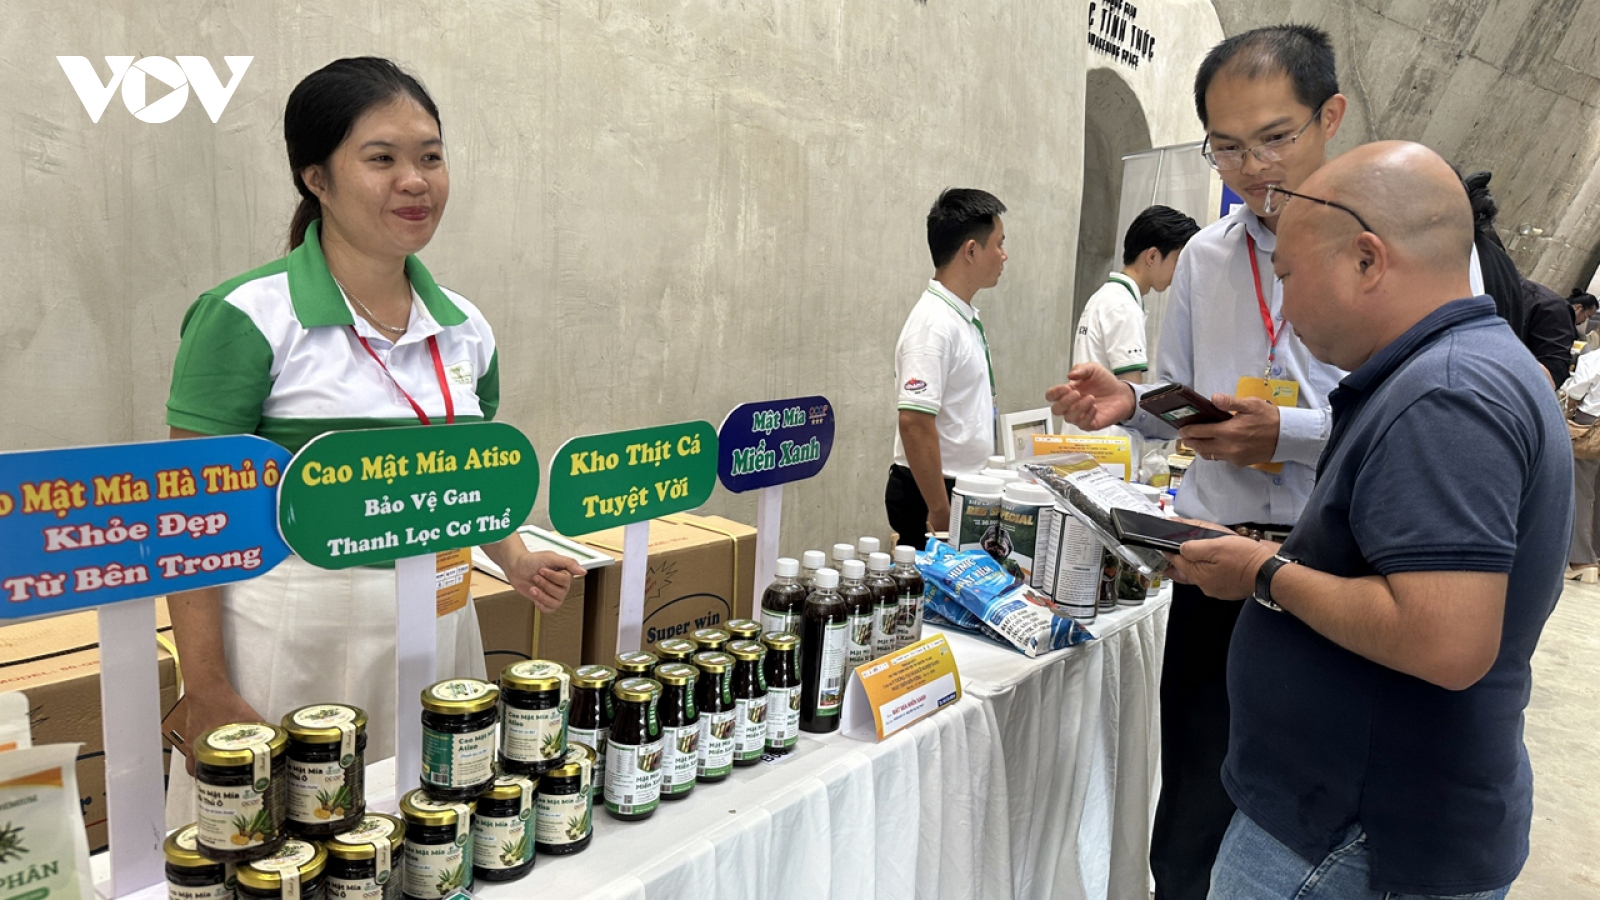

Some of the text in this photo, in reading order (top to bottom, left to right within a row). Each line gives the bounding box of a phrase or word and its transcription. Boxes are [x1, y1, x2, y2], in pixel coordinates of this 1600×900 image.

[752, 410, 782, 435] Mật
[783, 406, 807, 427] Mía
[302, 446, 521, 486] Cao Mật Mía Atiso
[570, 433, 701, 476] Kho Thịt Cá
[731, 436, 821, 476] Miền Xanh
[21, 479, 87, 518] Mật
[94, 474, 150, 506] Mía
[155, 468, 196, 499] Hà
[201, 459, 257, 494] Thủ
[262, 459, 281, 488] ô
[364, 489, 481, 517] Bảo Vệ Gan
[582, 477, 689, 518] Tuyệt Vời
[44, 512, 229, 552] Khỏe Đẹp
[327, 507, 511, 556] Thanh Lọc Cơ Thể
[3, 547, 262, 602] Từ Bên Trong
[646, 611, 720, 644] Super win
